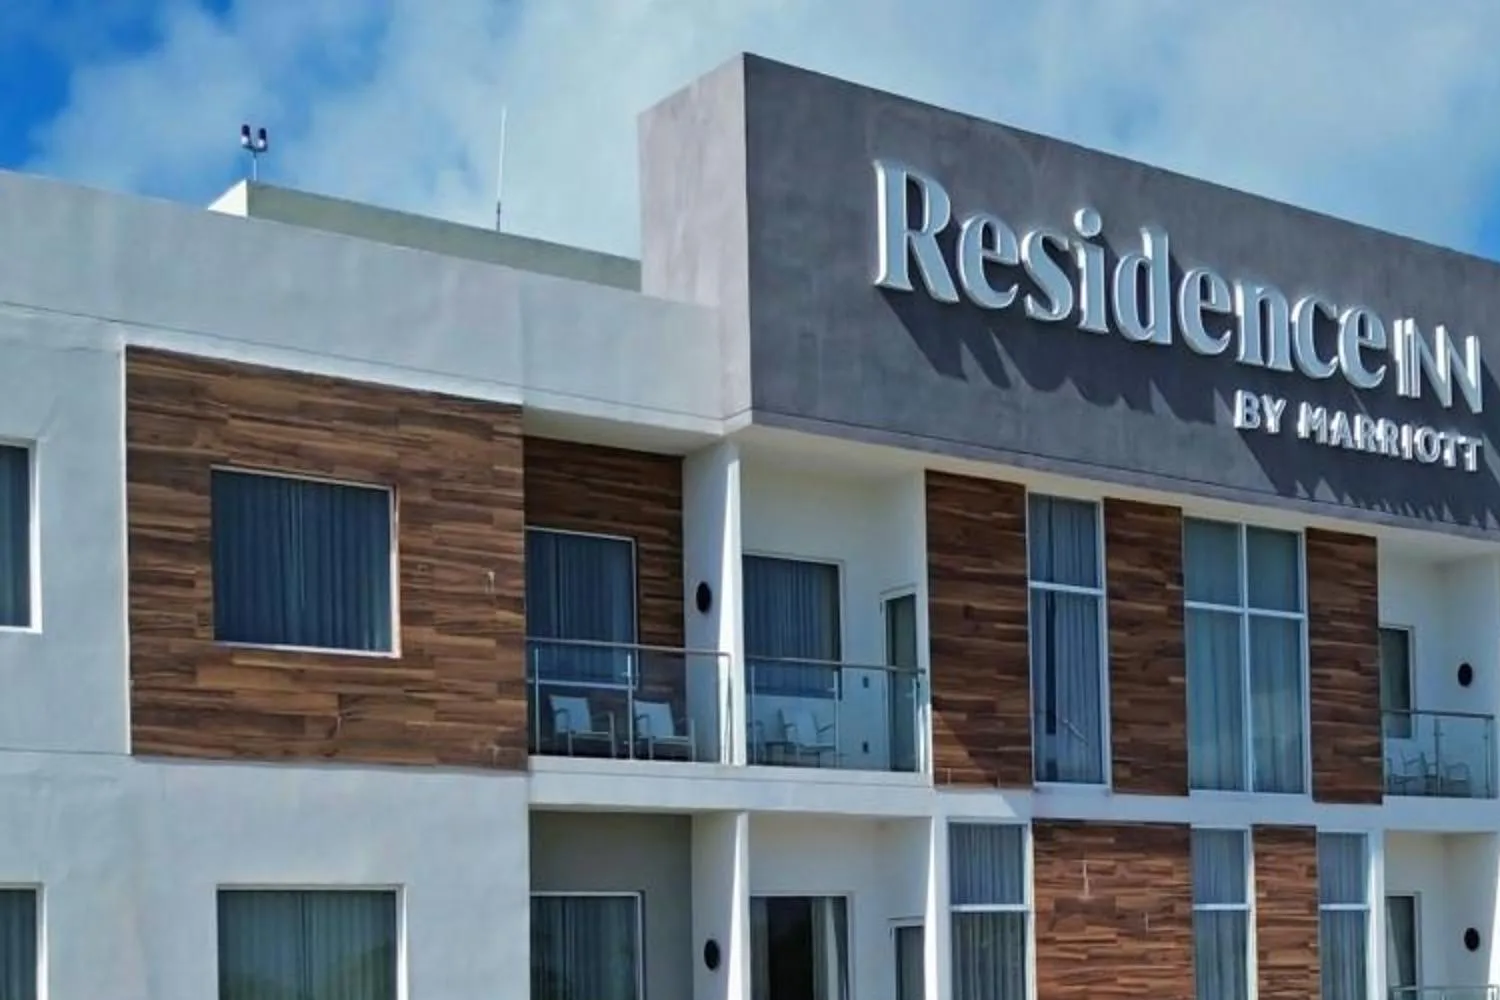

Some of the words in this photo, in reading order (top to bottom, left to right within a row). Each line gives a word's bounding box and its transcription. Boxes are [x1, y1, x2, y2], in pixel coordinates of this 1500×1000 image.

[873, 159, 1388, 389] Residence
[1233, 389, 1286, 434] BY
[1298, 403, 1484, 472] MARRIOTT
